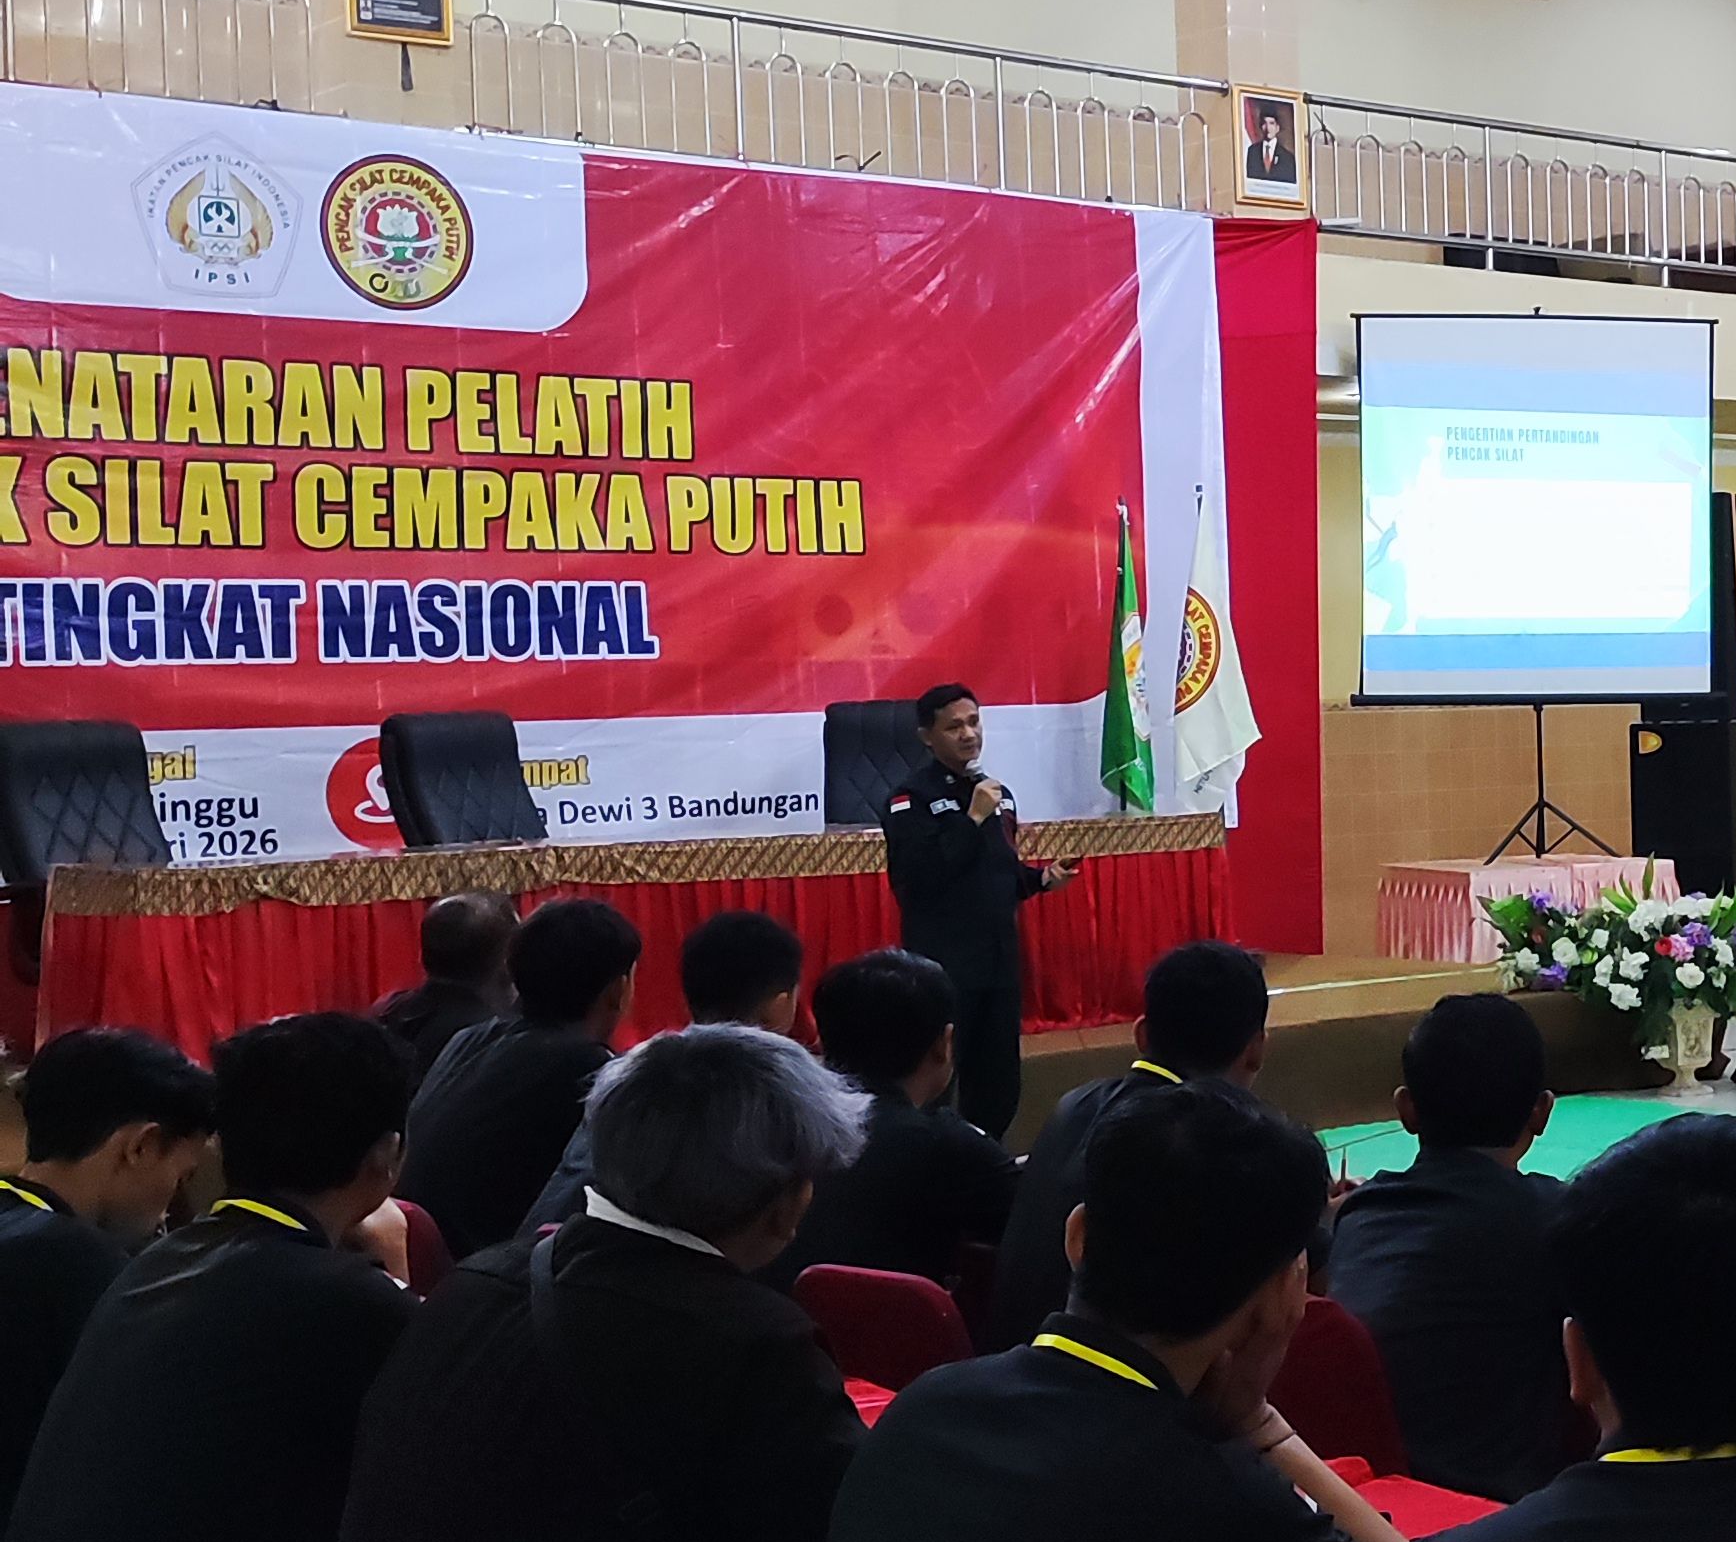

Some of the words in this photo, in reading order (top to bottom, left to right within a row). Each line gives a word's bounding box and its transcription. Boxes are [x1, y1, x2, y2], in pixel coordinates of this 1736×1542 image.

[215, 154, 249, 170] SILAT
[251, 169, 291, 230] INDONESIA
[334, 193, 357, 253] PENCAK
[389, 168, 452, 216] CEMPAKA
[194, 268, 250, 285] IPSI
[0, 345, 385, 452] NATARAN
[404, 366, 694, 461] PELATIH
[1446, 426, 1514, 442] PENGERTIAN
[1518, 428, 1600, 444] PERTANDINGAN
[1447, 446, 1490, 461] PENCAK
[1495, 447, 1524, 462] SILAT
[44, 455, 275, 549] SILAT
[290, 464, 656, 553] CEMPAKA
[664, 475, 865, 554] PUTIH
[0, 577, 307, 667] TINGKAT
[316, 578, 661, 664] NASIONAL
[558, 796, 633, 826] Dewi
[642, 796, 659, 821] 3
[668, 790, 820, 820] Bandungan
[197, 828, 279, 858] 2026
